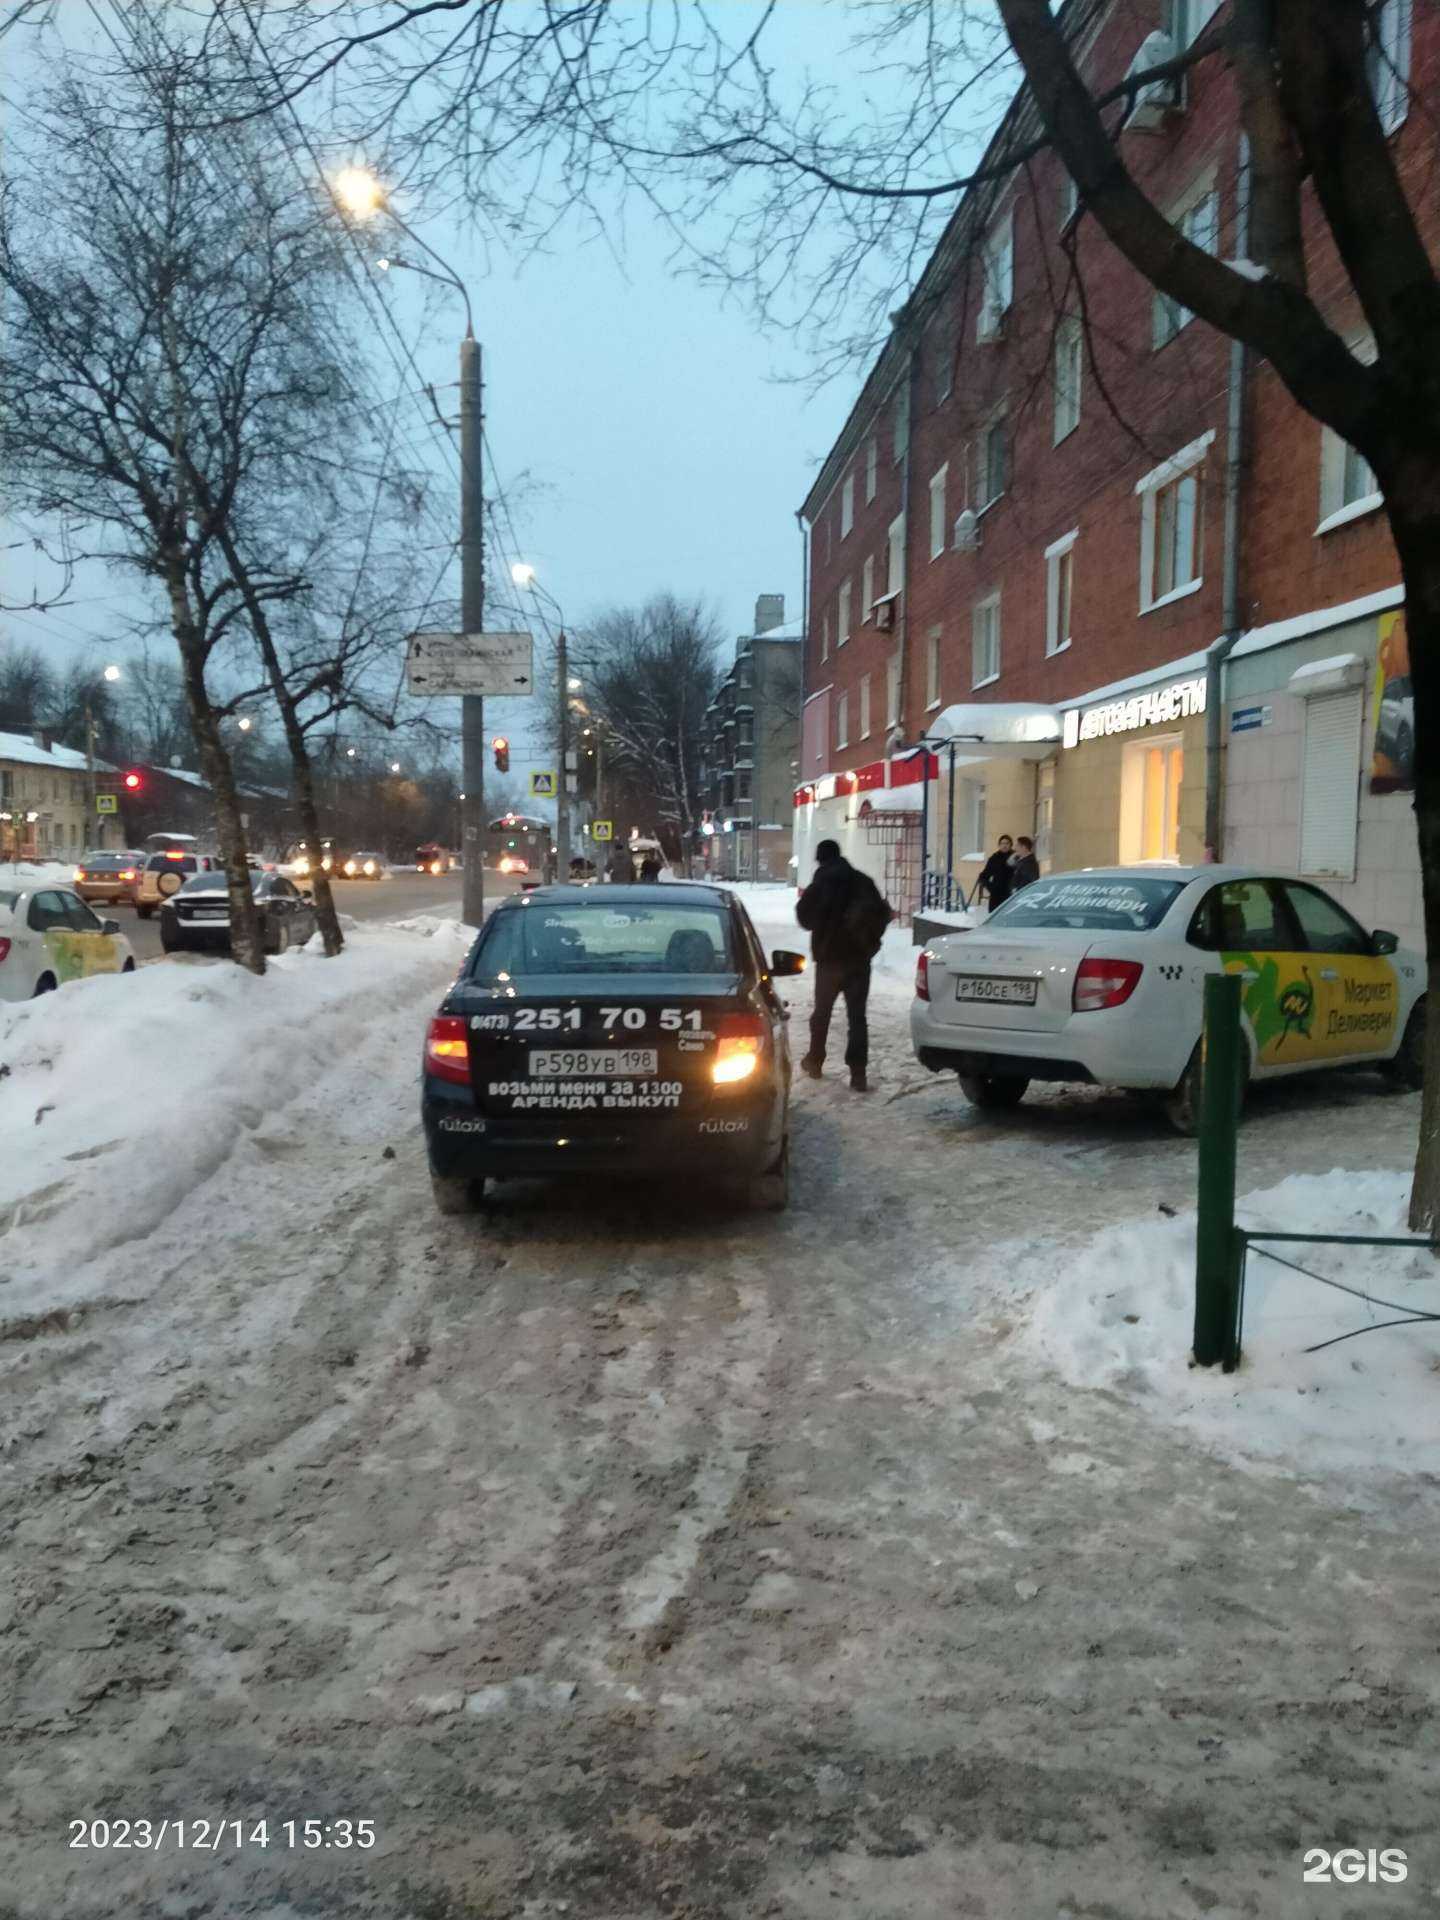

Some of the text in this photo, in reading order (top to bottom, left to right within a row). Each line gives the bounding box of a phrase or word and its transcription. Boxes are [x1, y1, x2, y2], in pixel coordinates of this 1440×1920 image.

[1079, 677, 1207, 740] АВТОЗАПЧАСТИ
[1058, 884, 1136, 895] Маркет
[1043, 895, 1149, 912] Деливери
[1344, 976, 1392, 1005] Маркет
[513, 1007, 581, 1030] 251
[599, 1007, 647, 1030] 70
[660, 1008, 702, 1031] 51
[1325, 1008, 1392, 1036] Деливери
[535, 1051, 652, 1074] Р598УВ 198
[639, 1081, 683, 1095] 1300
[511, 1095, 680, 1109] АРЕНДА ВЫКУП
